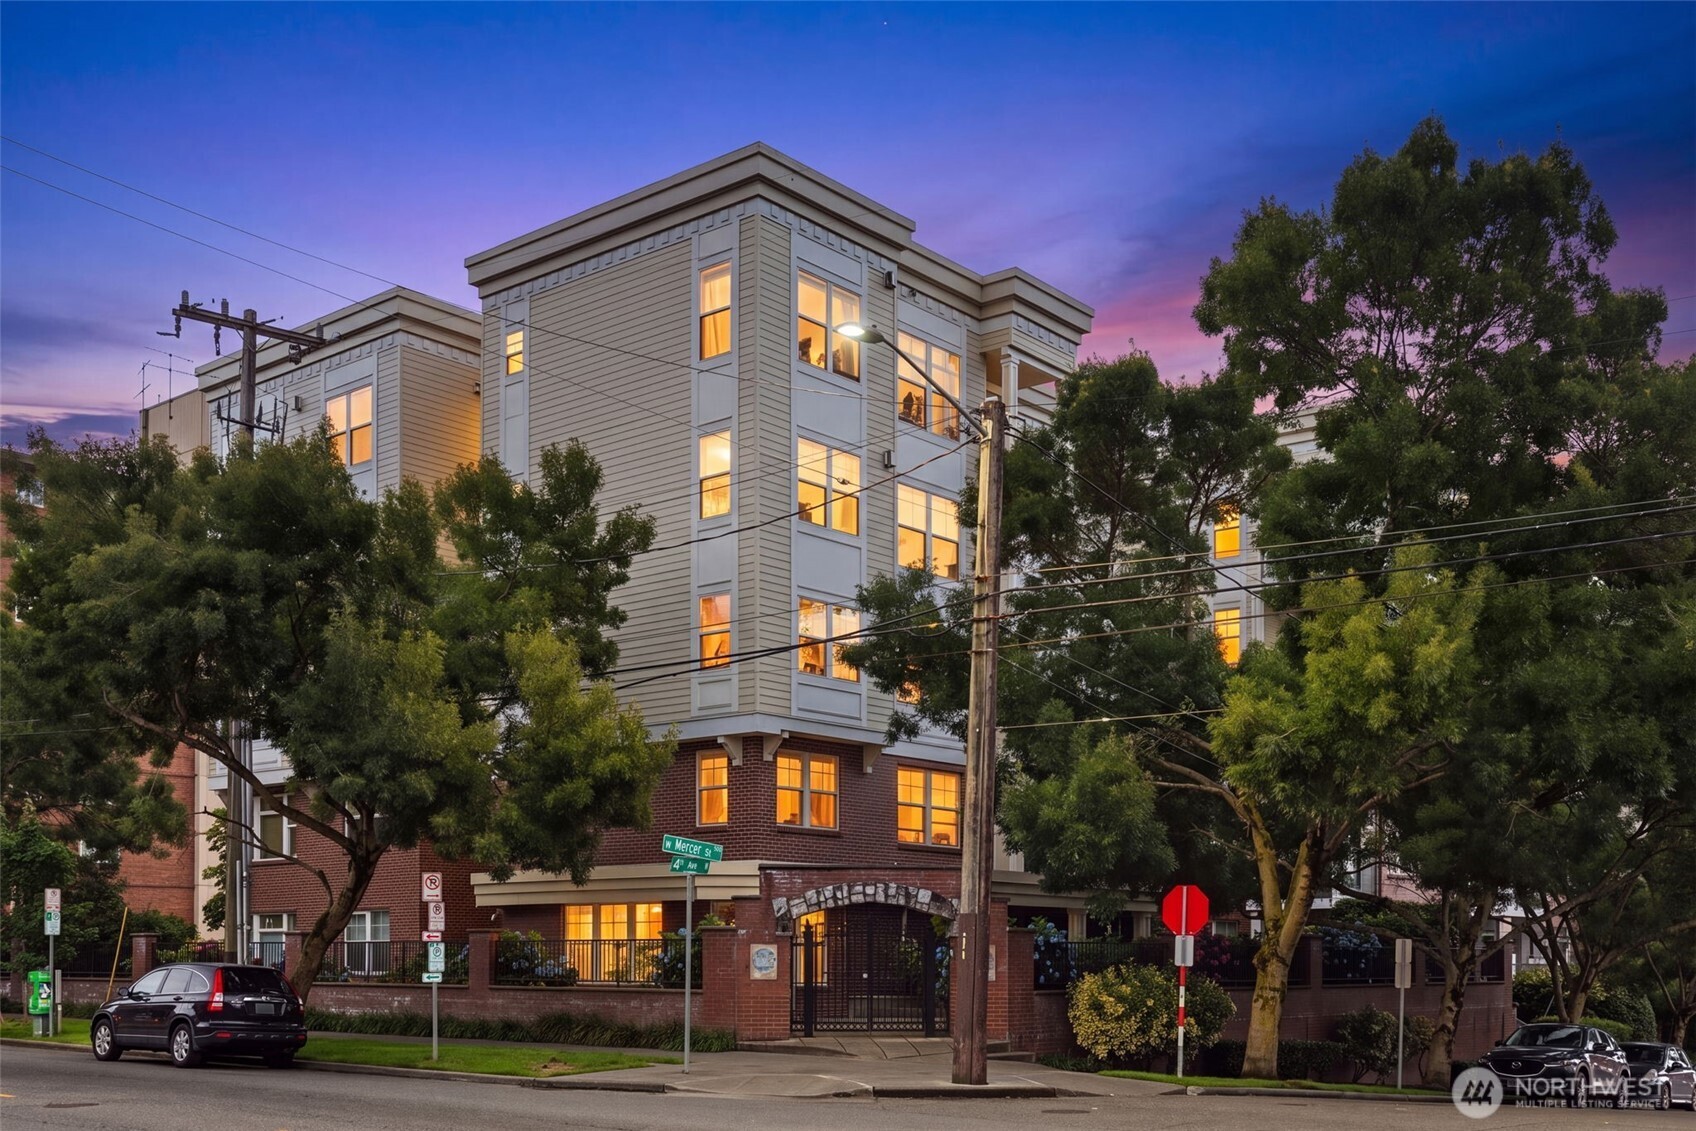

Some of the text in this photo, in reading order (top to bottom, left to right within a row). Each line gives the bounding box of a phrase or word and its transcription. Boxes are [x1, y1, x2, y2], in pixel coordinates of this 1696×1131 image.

[665, 839, 712, 857] W Mercer St
[687, 861, 698, 870] Ave
